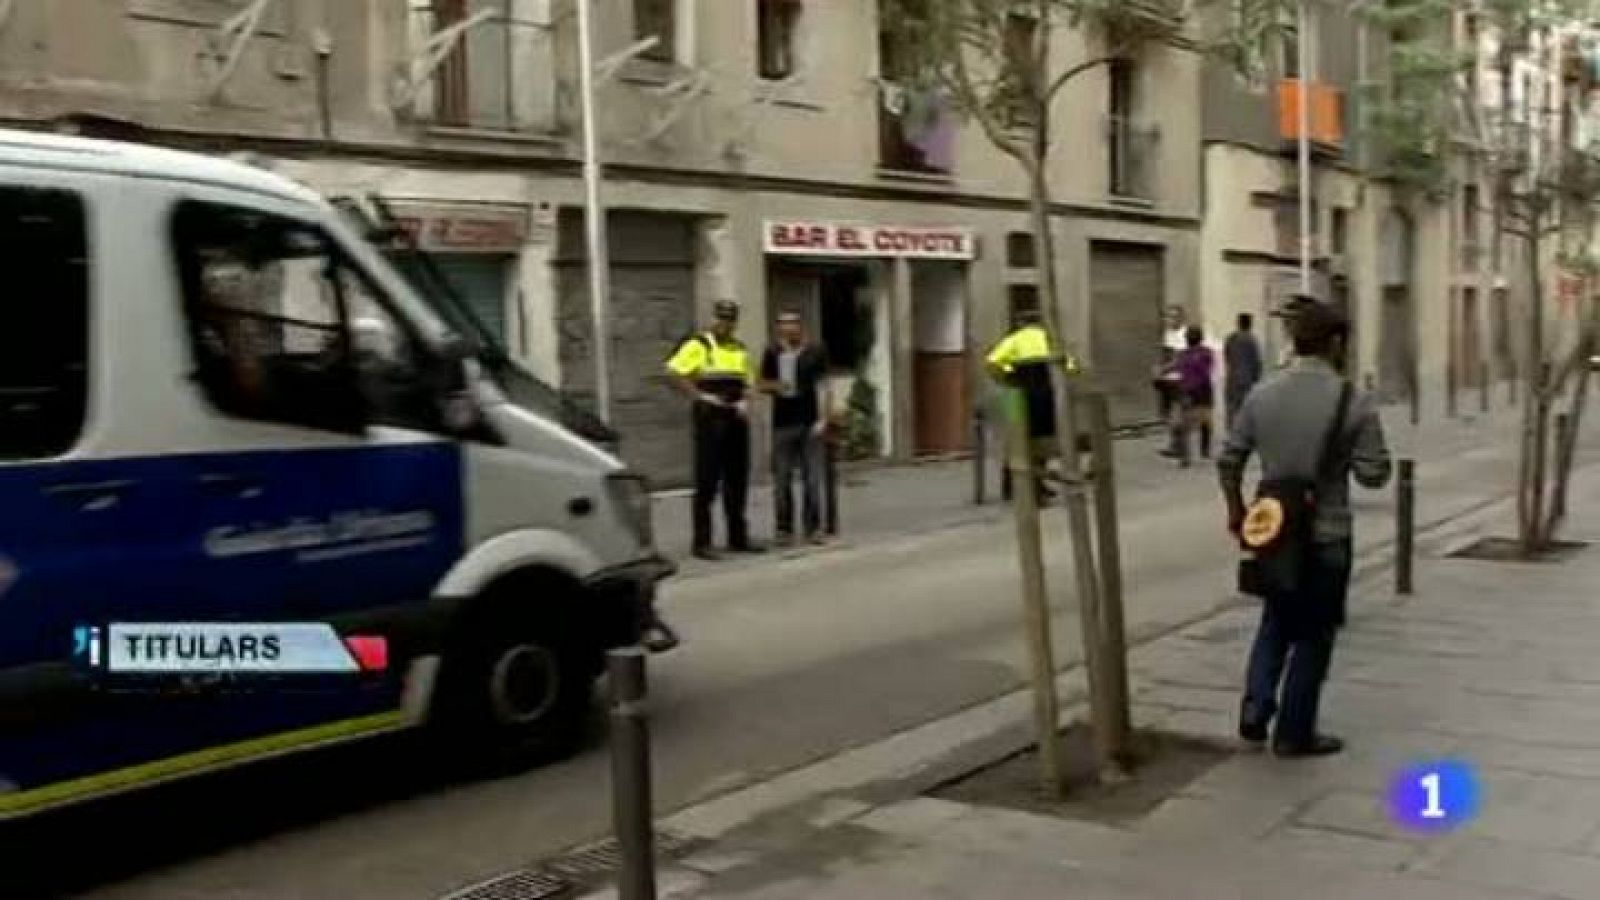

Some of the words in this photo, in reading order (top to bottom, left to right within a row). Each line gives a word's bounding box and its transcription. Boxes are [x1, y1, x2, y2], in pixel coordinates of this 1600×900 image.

[771, 225, 829, 248] BAR
[836, 228, 869, 250] EL
[873, 230, 965, 252] COYOTE
